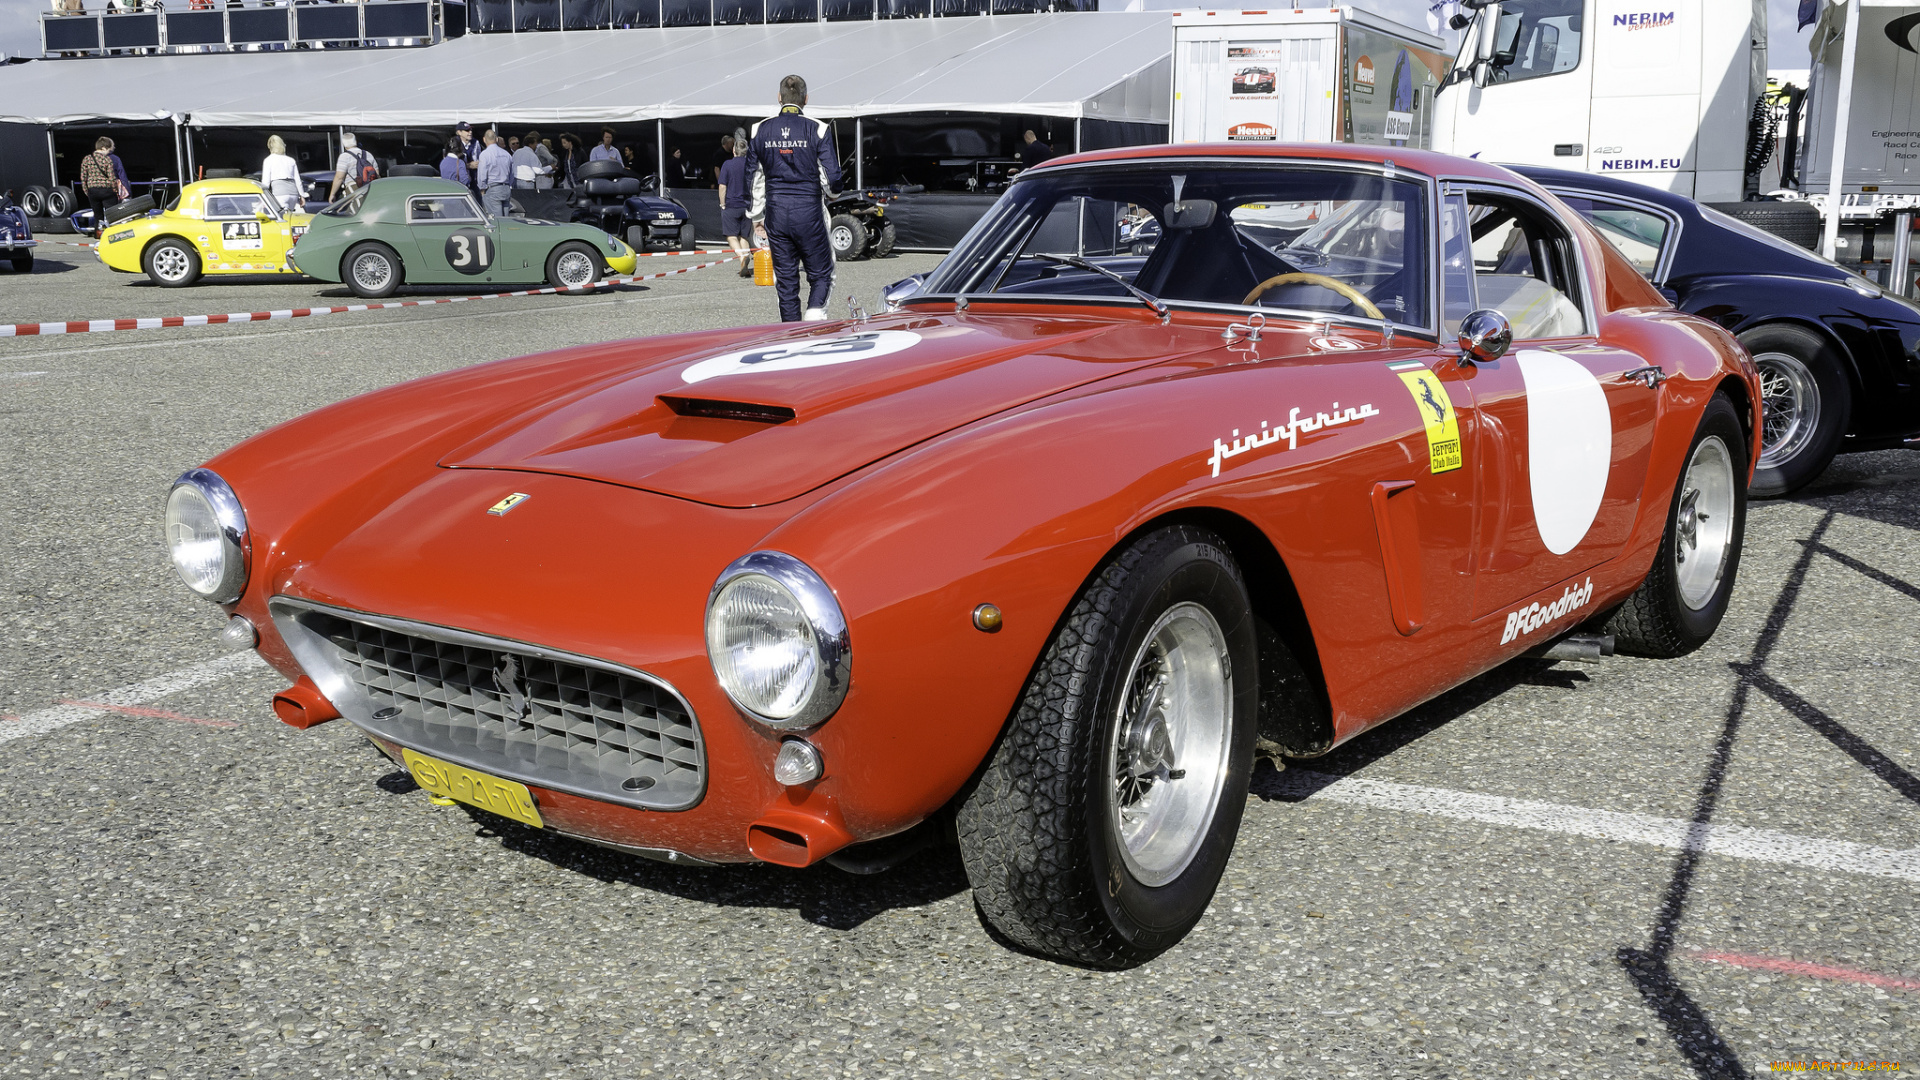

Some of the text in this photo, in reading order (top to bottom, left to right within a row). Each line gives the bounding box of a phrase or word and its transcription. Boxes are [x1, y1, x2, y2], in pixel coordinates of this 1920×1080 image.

[1613, 11, 1674, 26] NEBIM
[1237, 125, 1275, 135] Heuvel
[1871, 130, 1920, 138] Engineering
[765, 140, 808, 148] MASERATI
[1593, 146, 1622, 154] 420
[1602, 158, 1681, 170] NEBIM.EU
[241, 222, 258, 235] 16
[451, 235, 488, 266] 31
[1207, 402, 1380, 478] pininfarina
[1432, 439, 1459, 457] Ferrari
[1433, 455, 1460, 469] Club Italia
[1500, 575, 1594, 646] BFGoodrich
